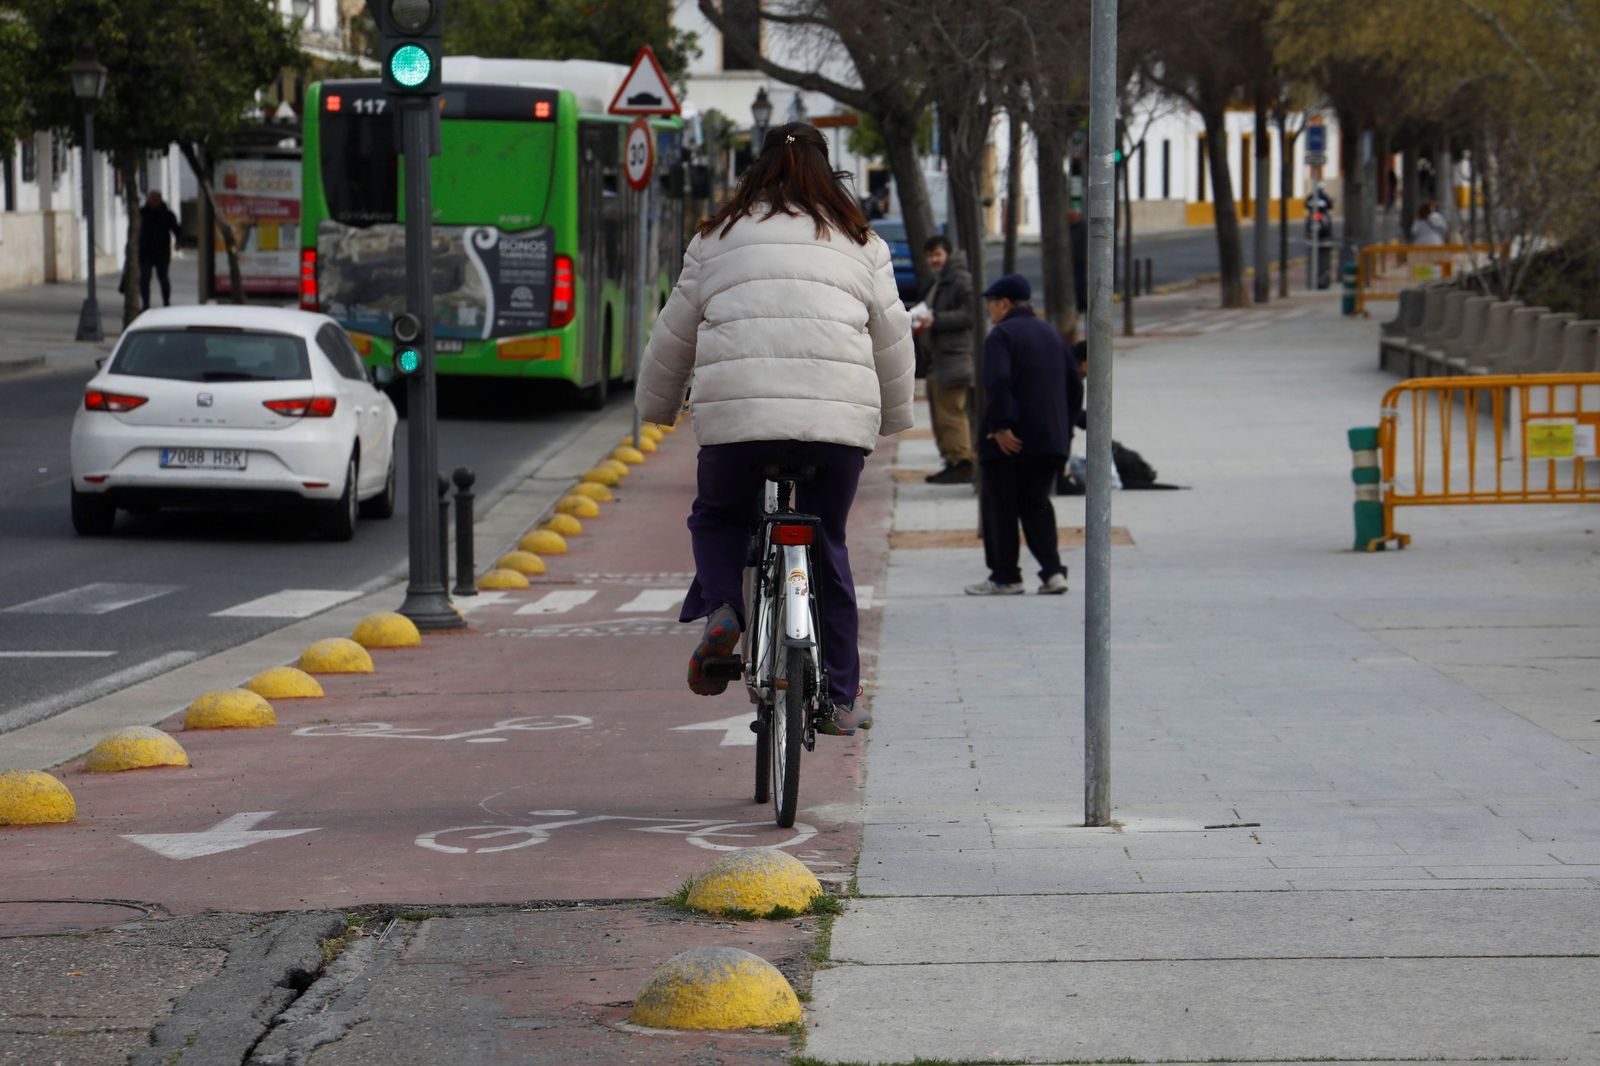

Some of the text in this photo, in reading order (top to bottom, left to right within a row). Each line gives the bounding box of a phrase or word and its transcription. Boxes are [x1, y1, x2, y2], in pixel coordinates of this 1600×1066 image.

[353, 100, 386, 114] 117
[630, 143, 645, 166] 30
[498, 240, 547, 252] BONOS
[169, 449, 242, 465] 7088 HSK
